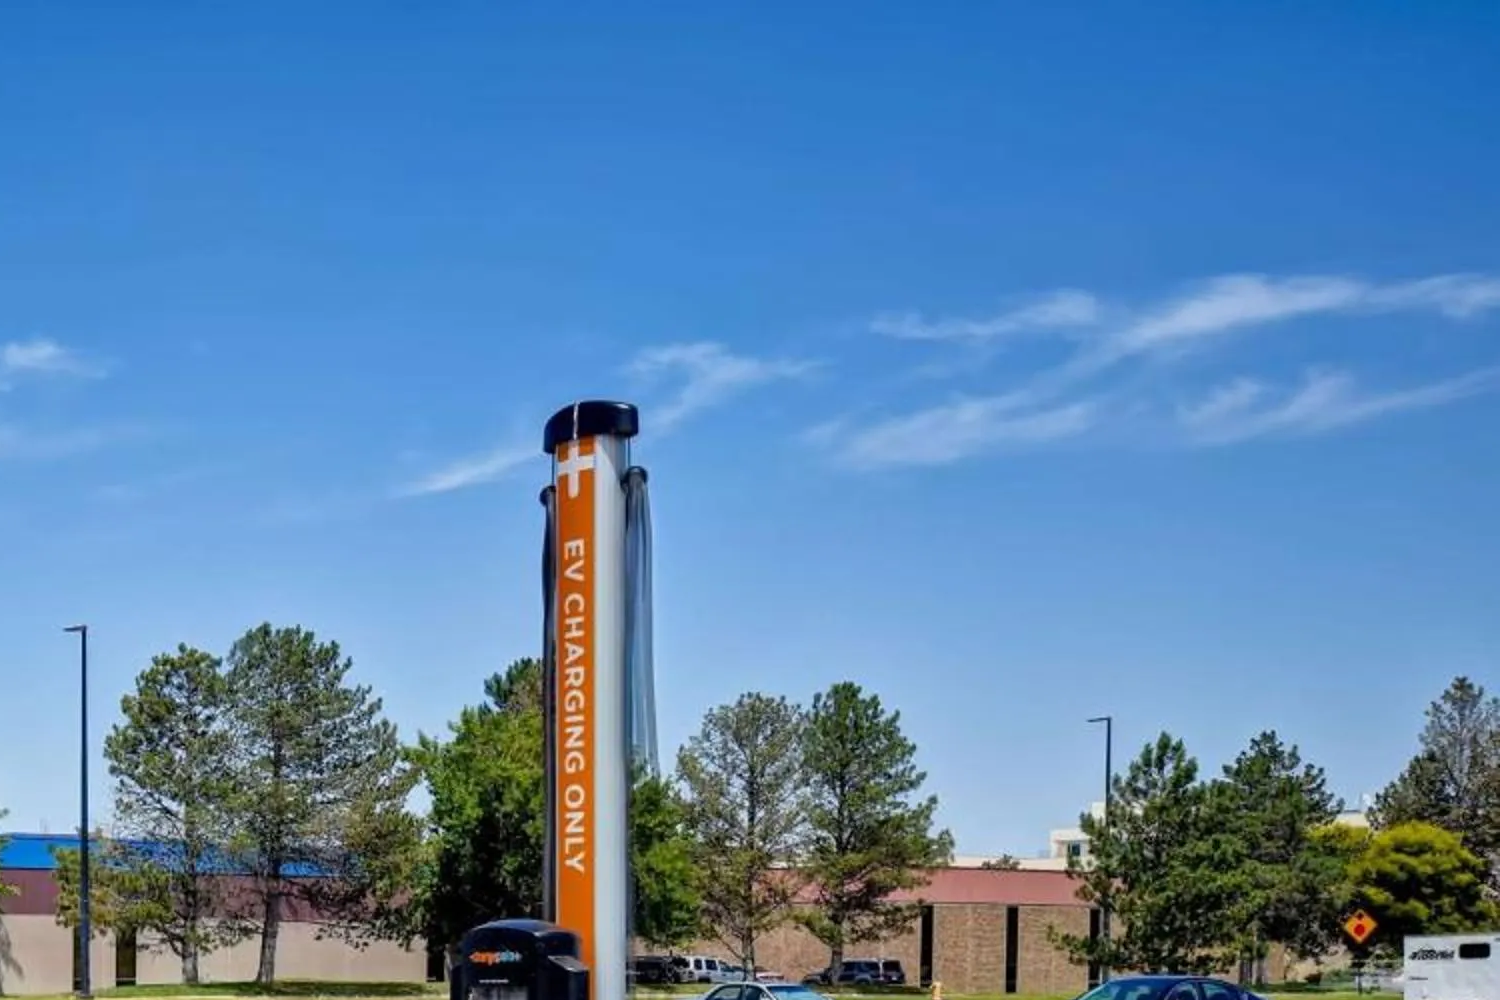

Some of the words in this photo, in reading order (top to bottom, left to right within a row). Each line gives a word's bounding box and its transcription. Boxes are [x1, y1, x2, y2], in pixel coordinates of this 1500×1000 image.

[564, 538, 585, 582] EV
[564, 593, 585, 774] CHARGING
[564, 784, 585, 874] ONLY
